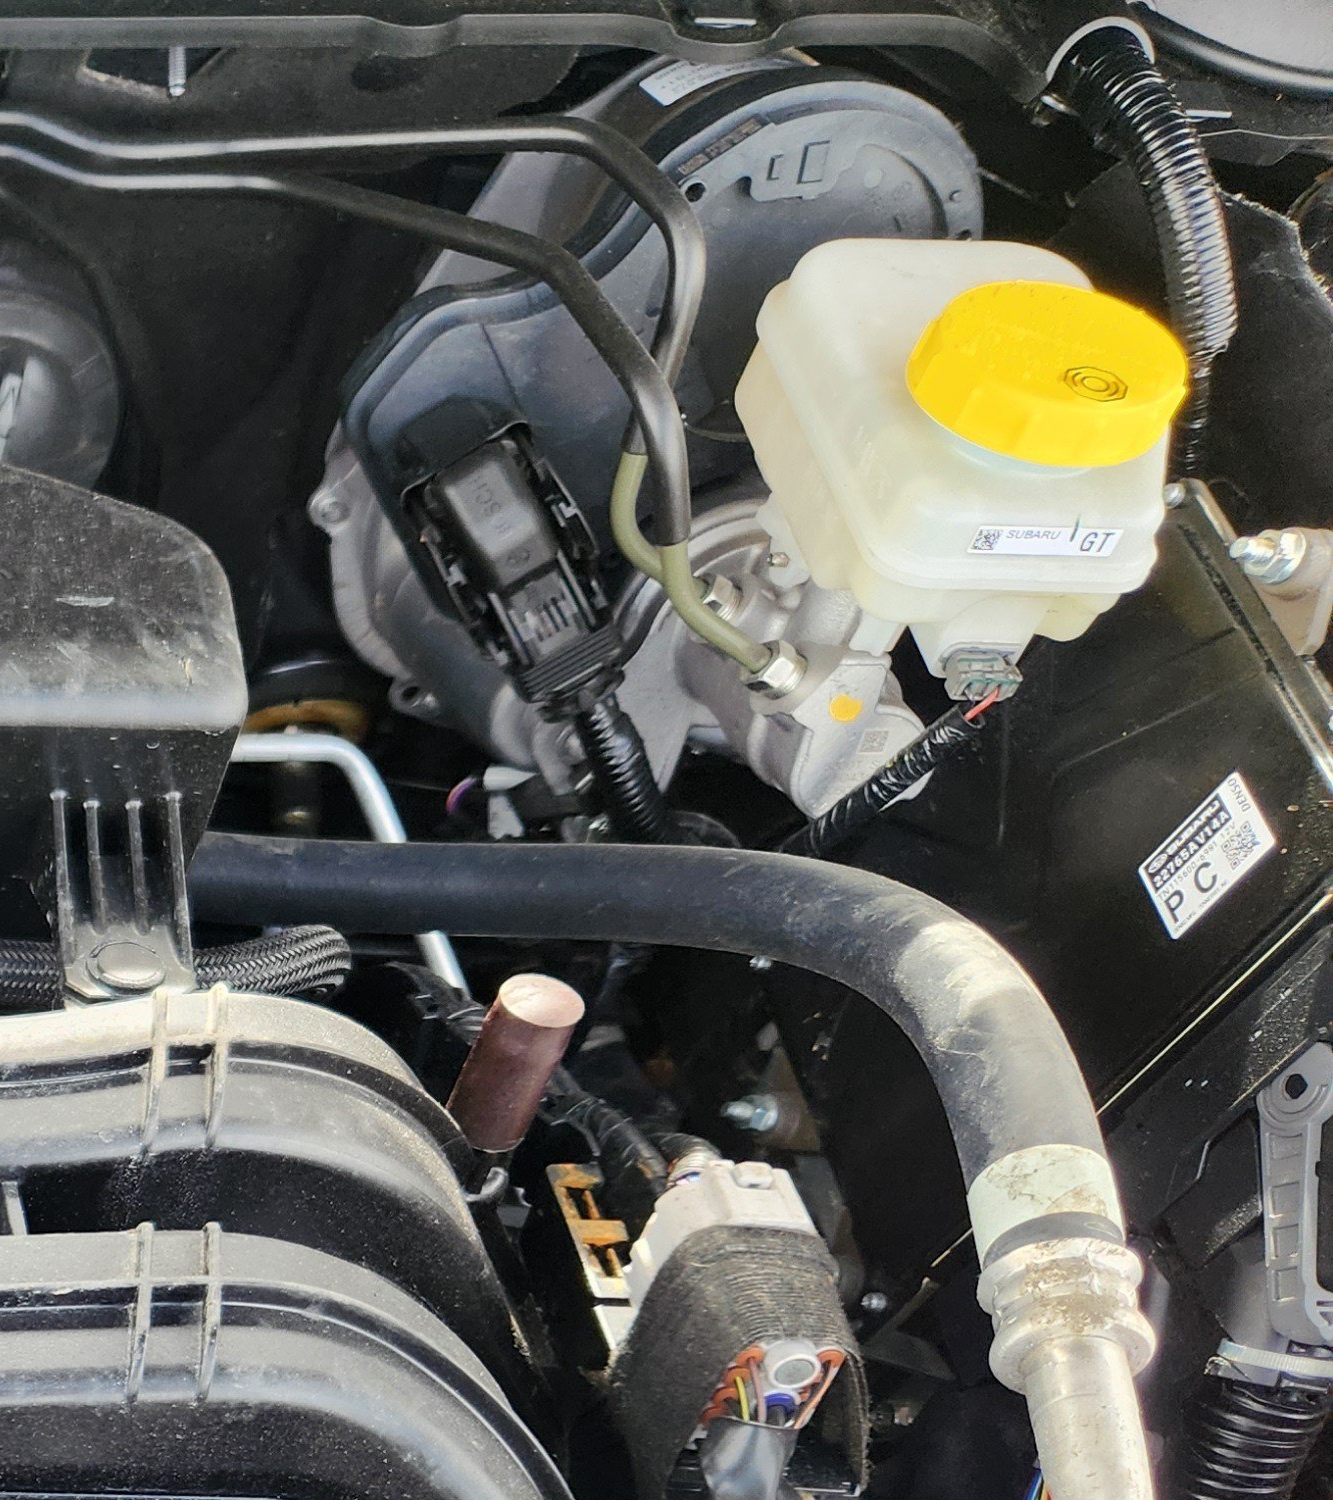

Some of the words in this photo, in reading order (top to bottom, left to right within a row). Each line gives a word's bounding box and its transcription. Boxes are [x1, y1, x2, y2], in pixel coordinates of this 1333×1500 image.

[1006, 529, 1062, 541] SUBARU
[1080, 532, 1116, 553] GT
[1227, 778, 1252, 812] DENSO
[1152, 810, 1230, 888] 22765AV14A
[1166, 799, 1221, 856] SUBARU
[1165, 890, 1184, 924] P
[1194, 861, 1218, 893] C
